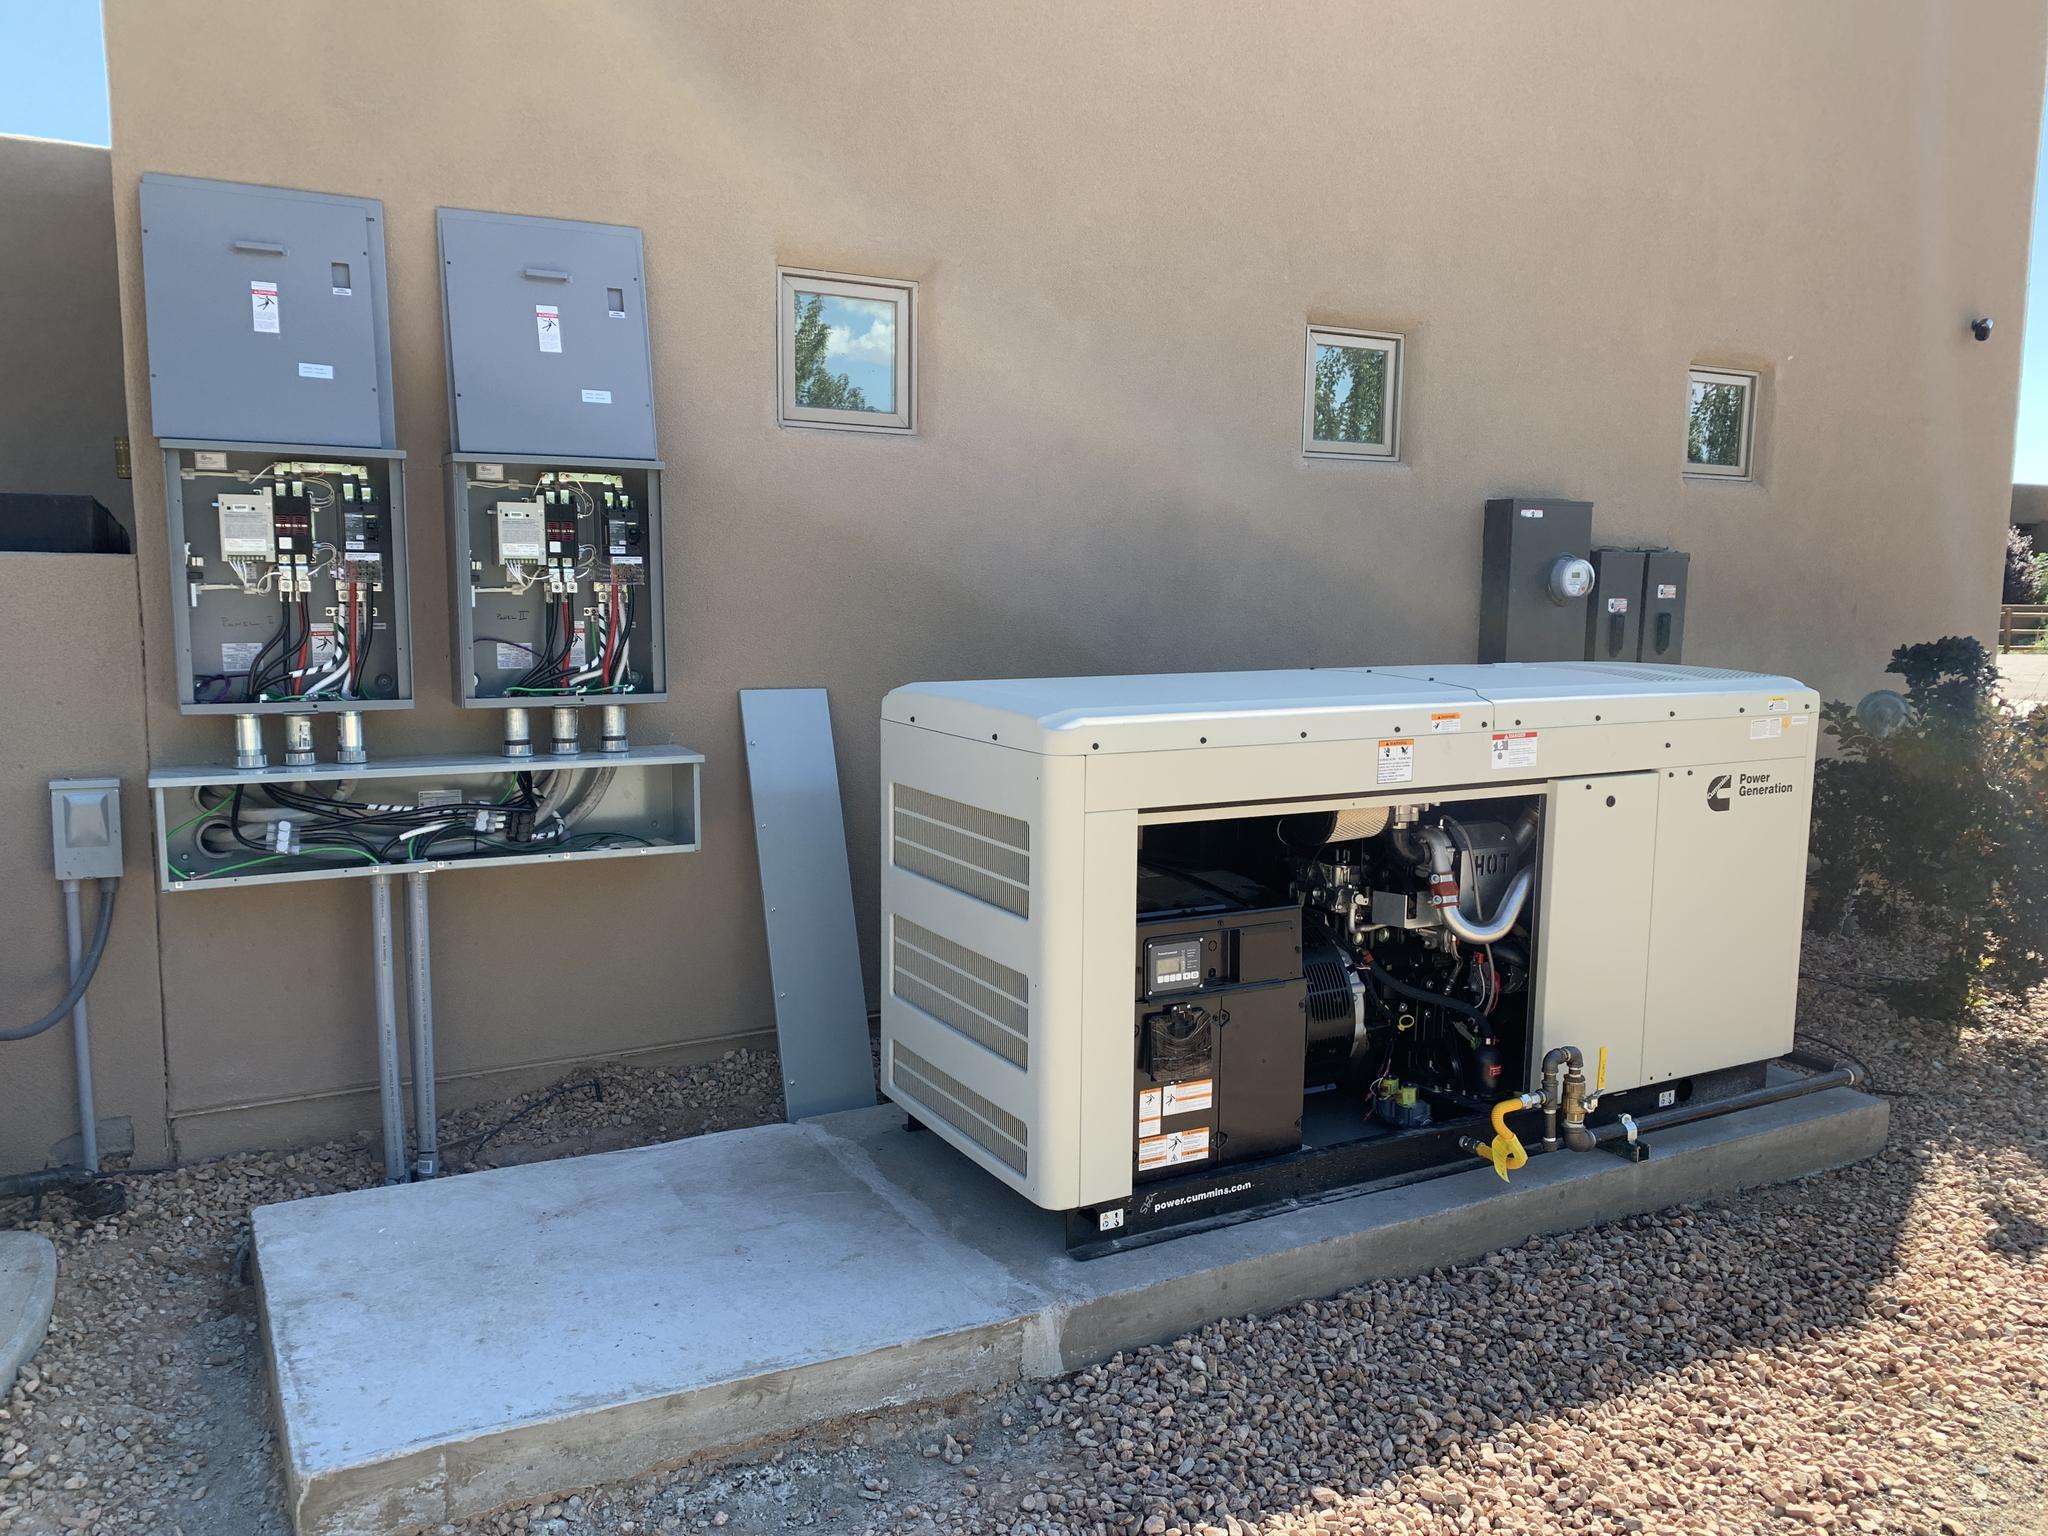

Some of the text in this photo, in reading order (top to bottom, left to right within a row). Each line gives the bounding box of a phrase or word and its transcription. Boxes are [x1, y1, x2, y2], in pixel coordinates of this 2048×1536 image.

[1739, 773, 1771, 785] Power
[1739, 782, 1793, 797] Generation
[1475, 853, 1509, 876] HOT
[1154, 1181, 1252, 1213] power.cummins.com
